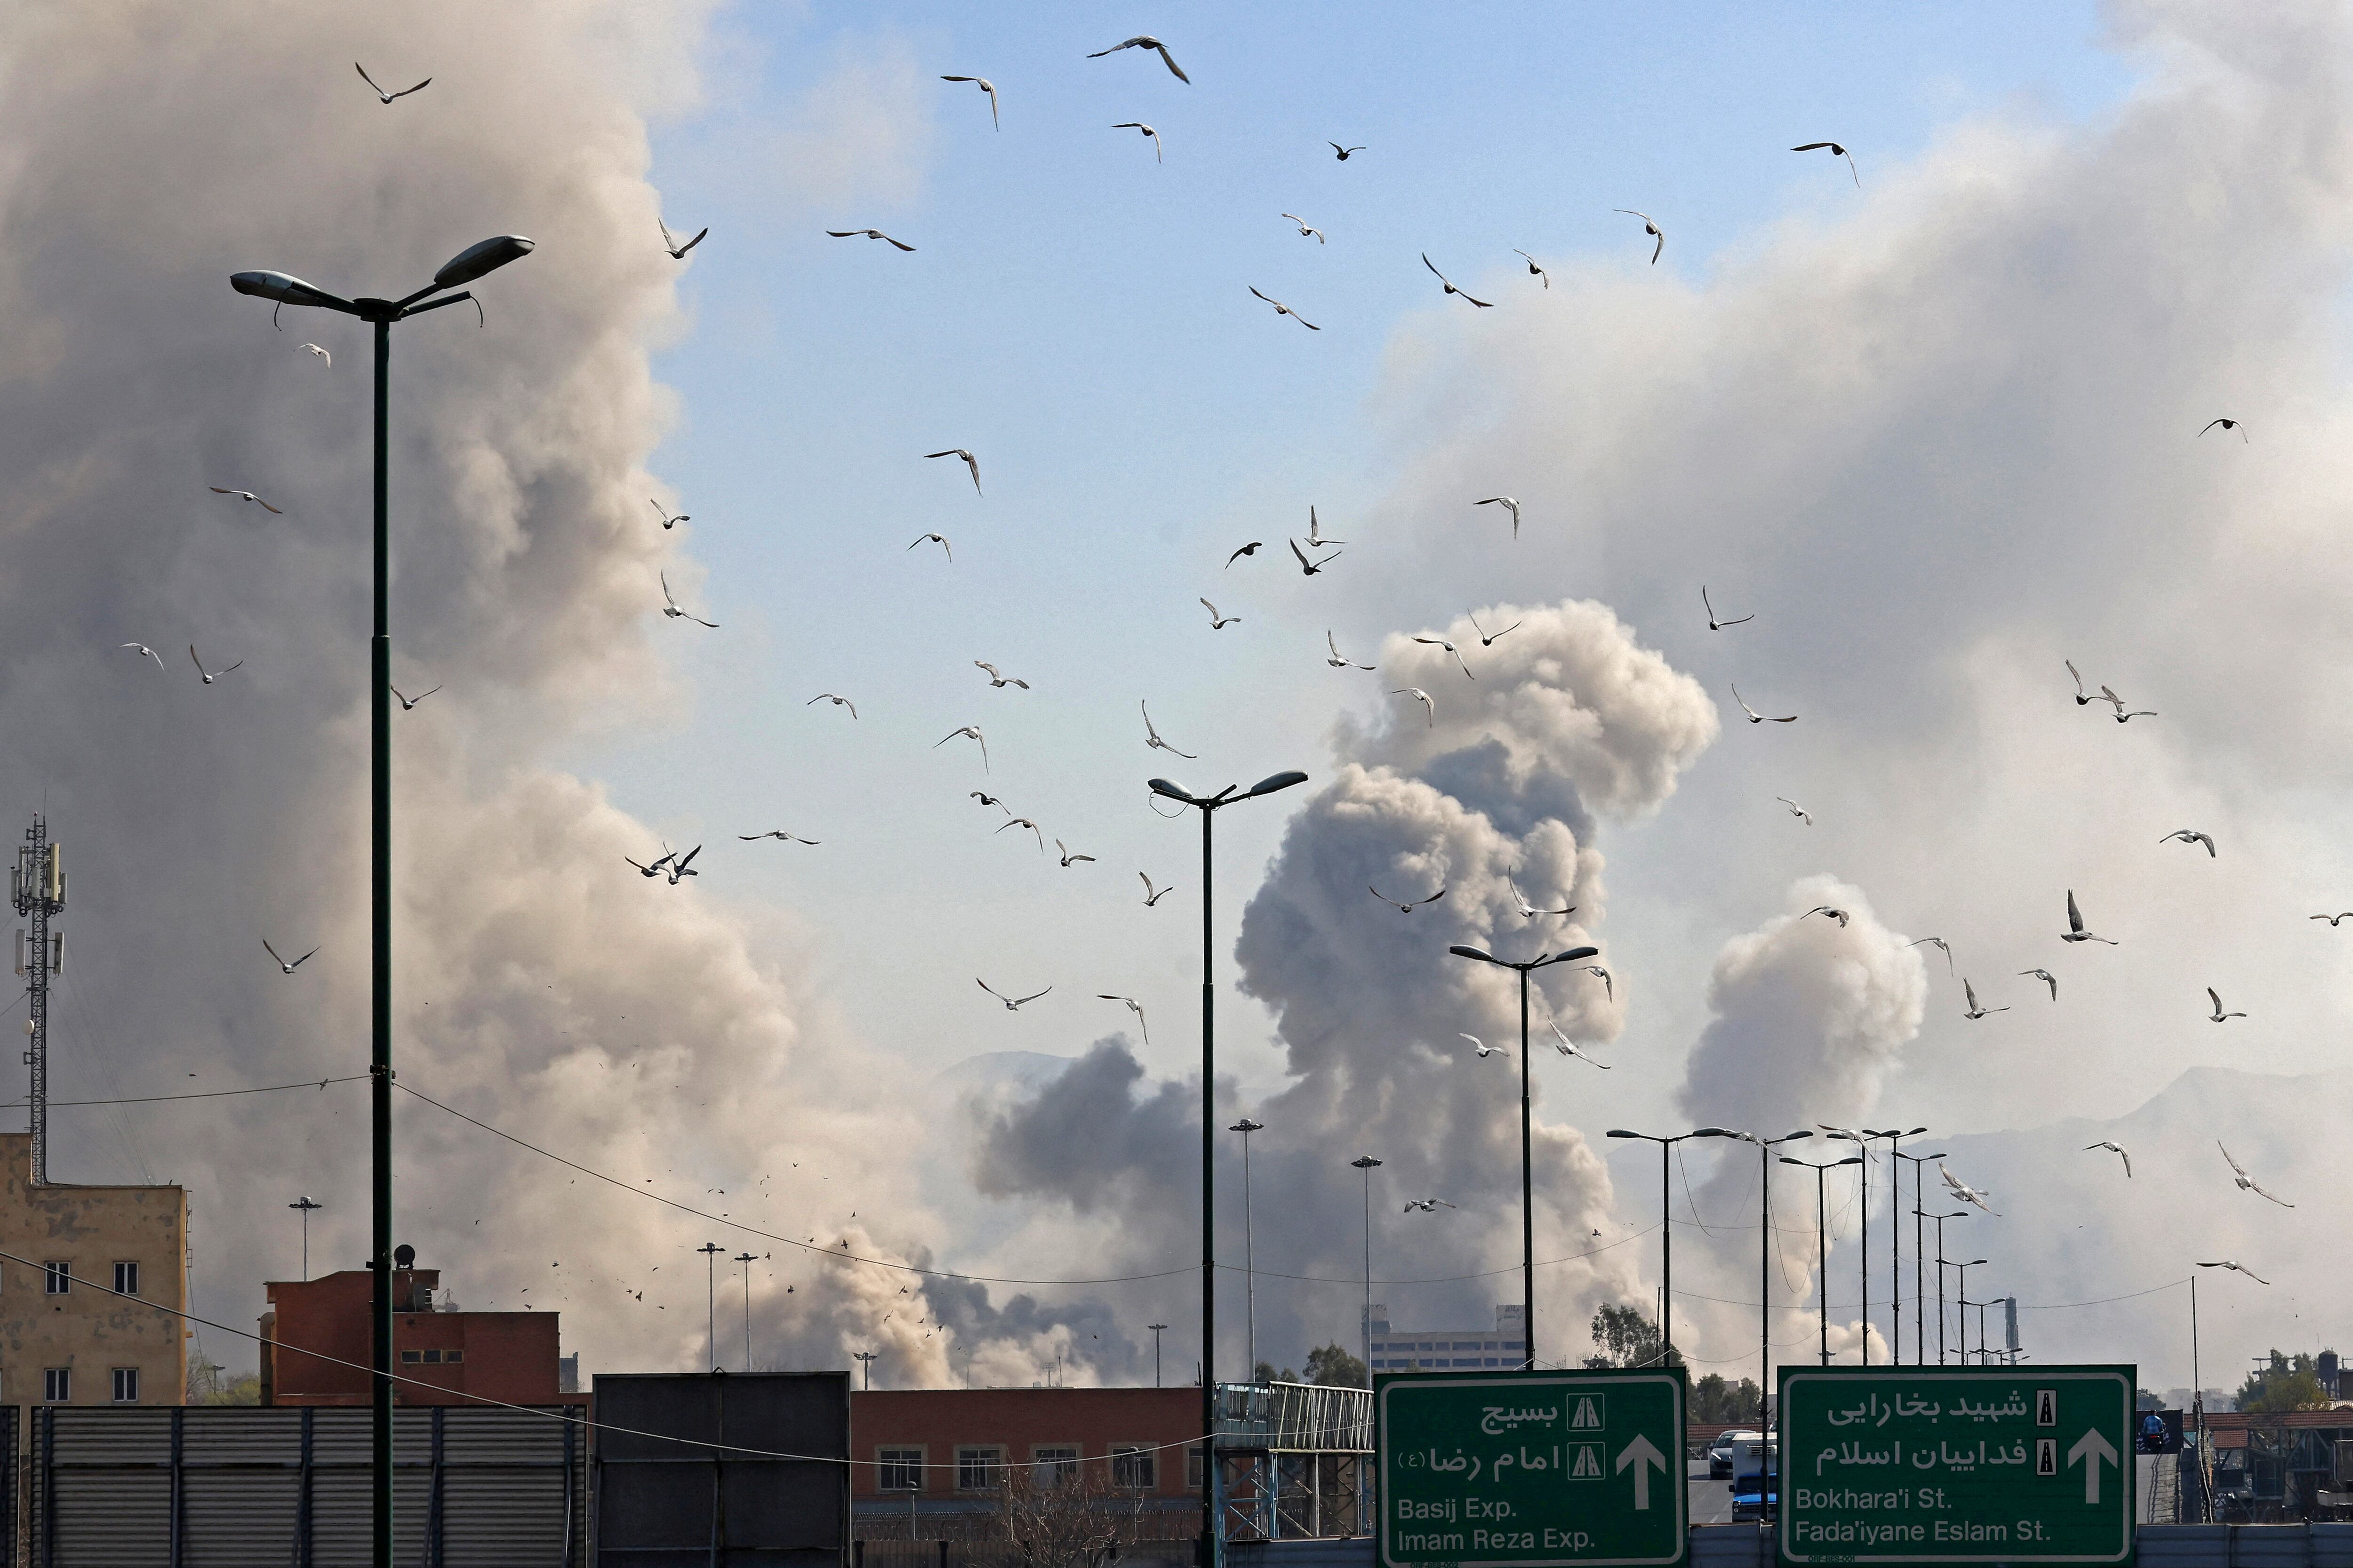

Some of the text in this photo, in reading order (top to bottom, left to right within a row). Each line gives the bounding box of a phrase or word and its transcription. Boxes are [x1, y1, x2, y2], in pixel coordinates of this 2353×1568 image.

[1481, 1406, 1558, 1434] بسیج
[1828, 1391, 2027, 1427] شهید بخارایی
[1430, 1448, 1481, 1481] رضا
[1494, 1445, 1559, 1482] امام
[1817, 1439, 2027, 1476] فداییان اسلام
[1398, 1497, 1517, 1523] Basij Exp.
[1796, 1488, 1952, 1509] Bokhara'i St.
[1399, 1528, 1595, 1552] Imam Reza Exp.
[1796, 1520, 2051, 1545] Fada'iyane Eslam St.
